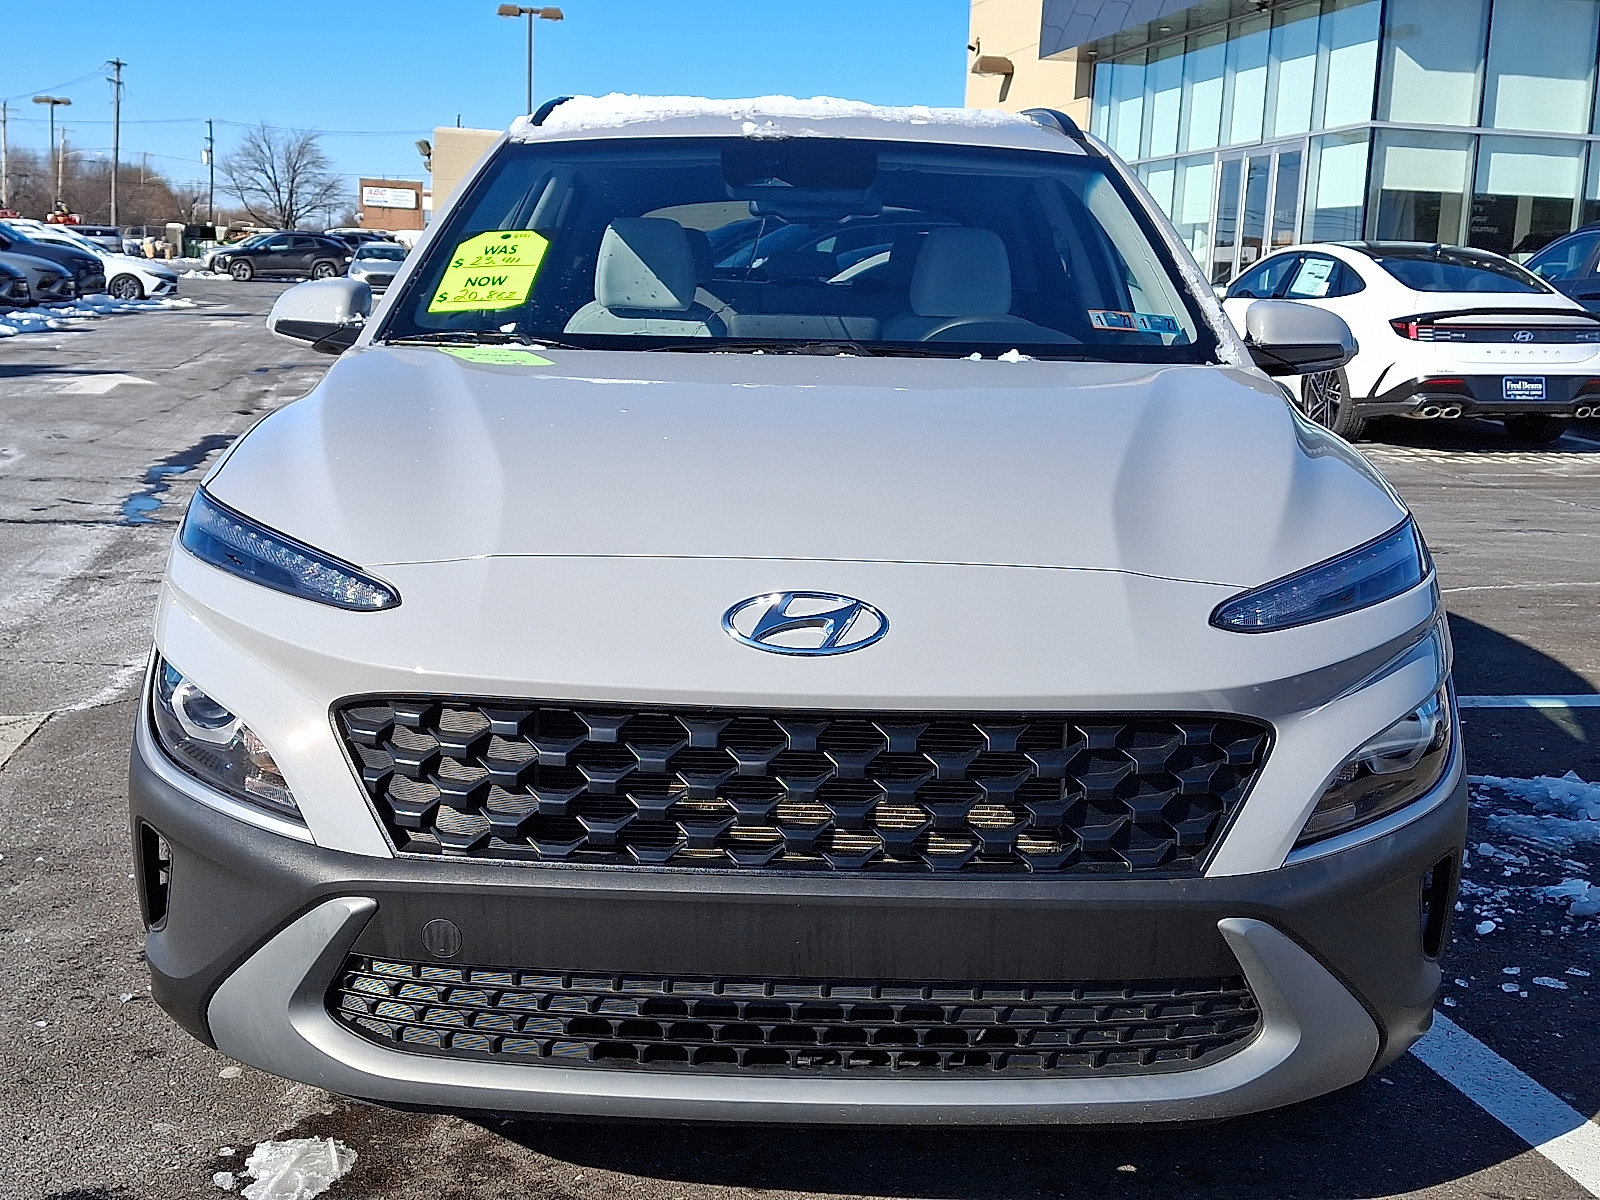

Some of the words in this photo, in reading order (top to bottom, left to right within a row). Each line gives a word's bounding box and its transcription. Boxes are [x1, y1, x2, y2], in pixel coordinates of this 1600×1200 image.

[484, 245, 518, 255] WAS
[452, 258, 464, 269] $
[464, 276, 508, 287] NOW
[436, 292, 448, 303] $
